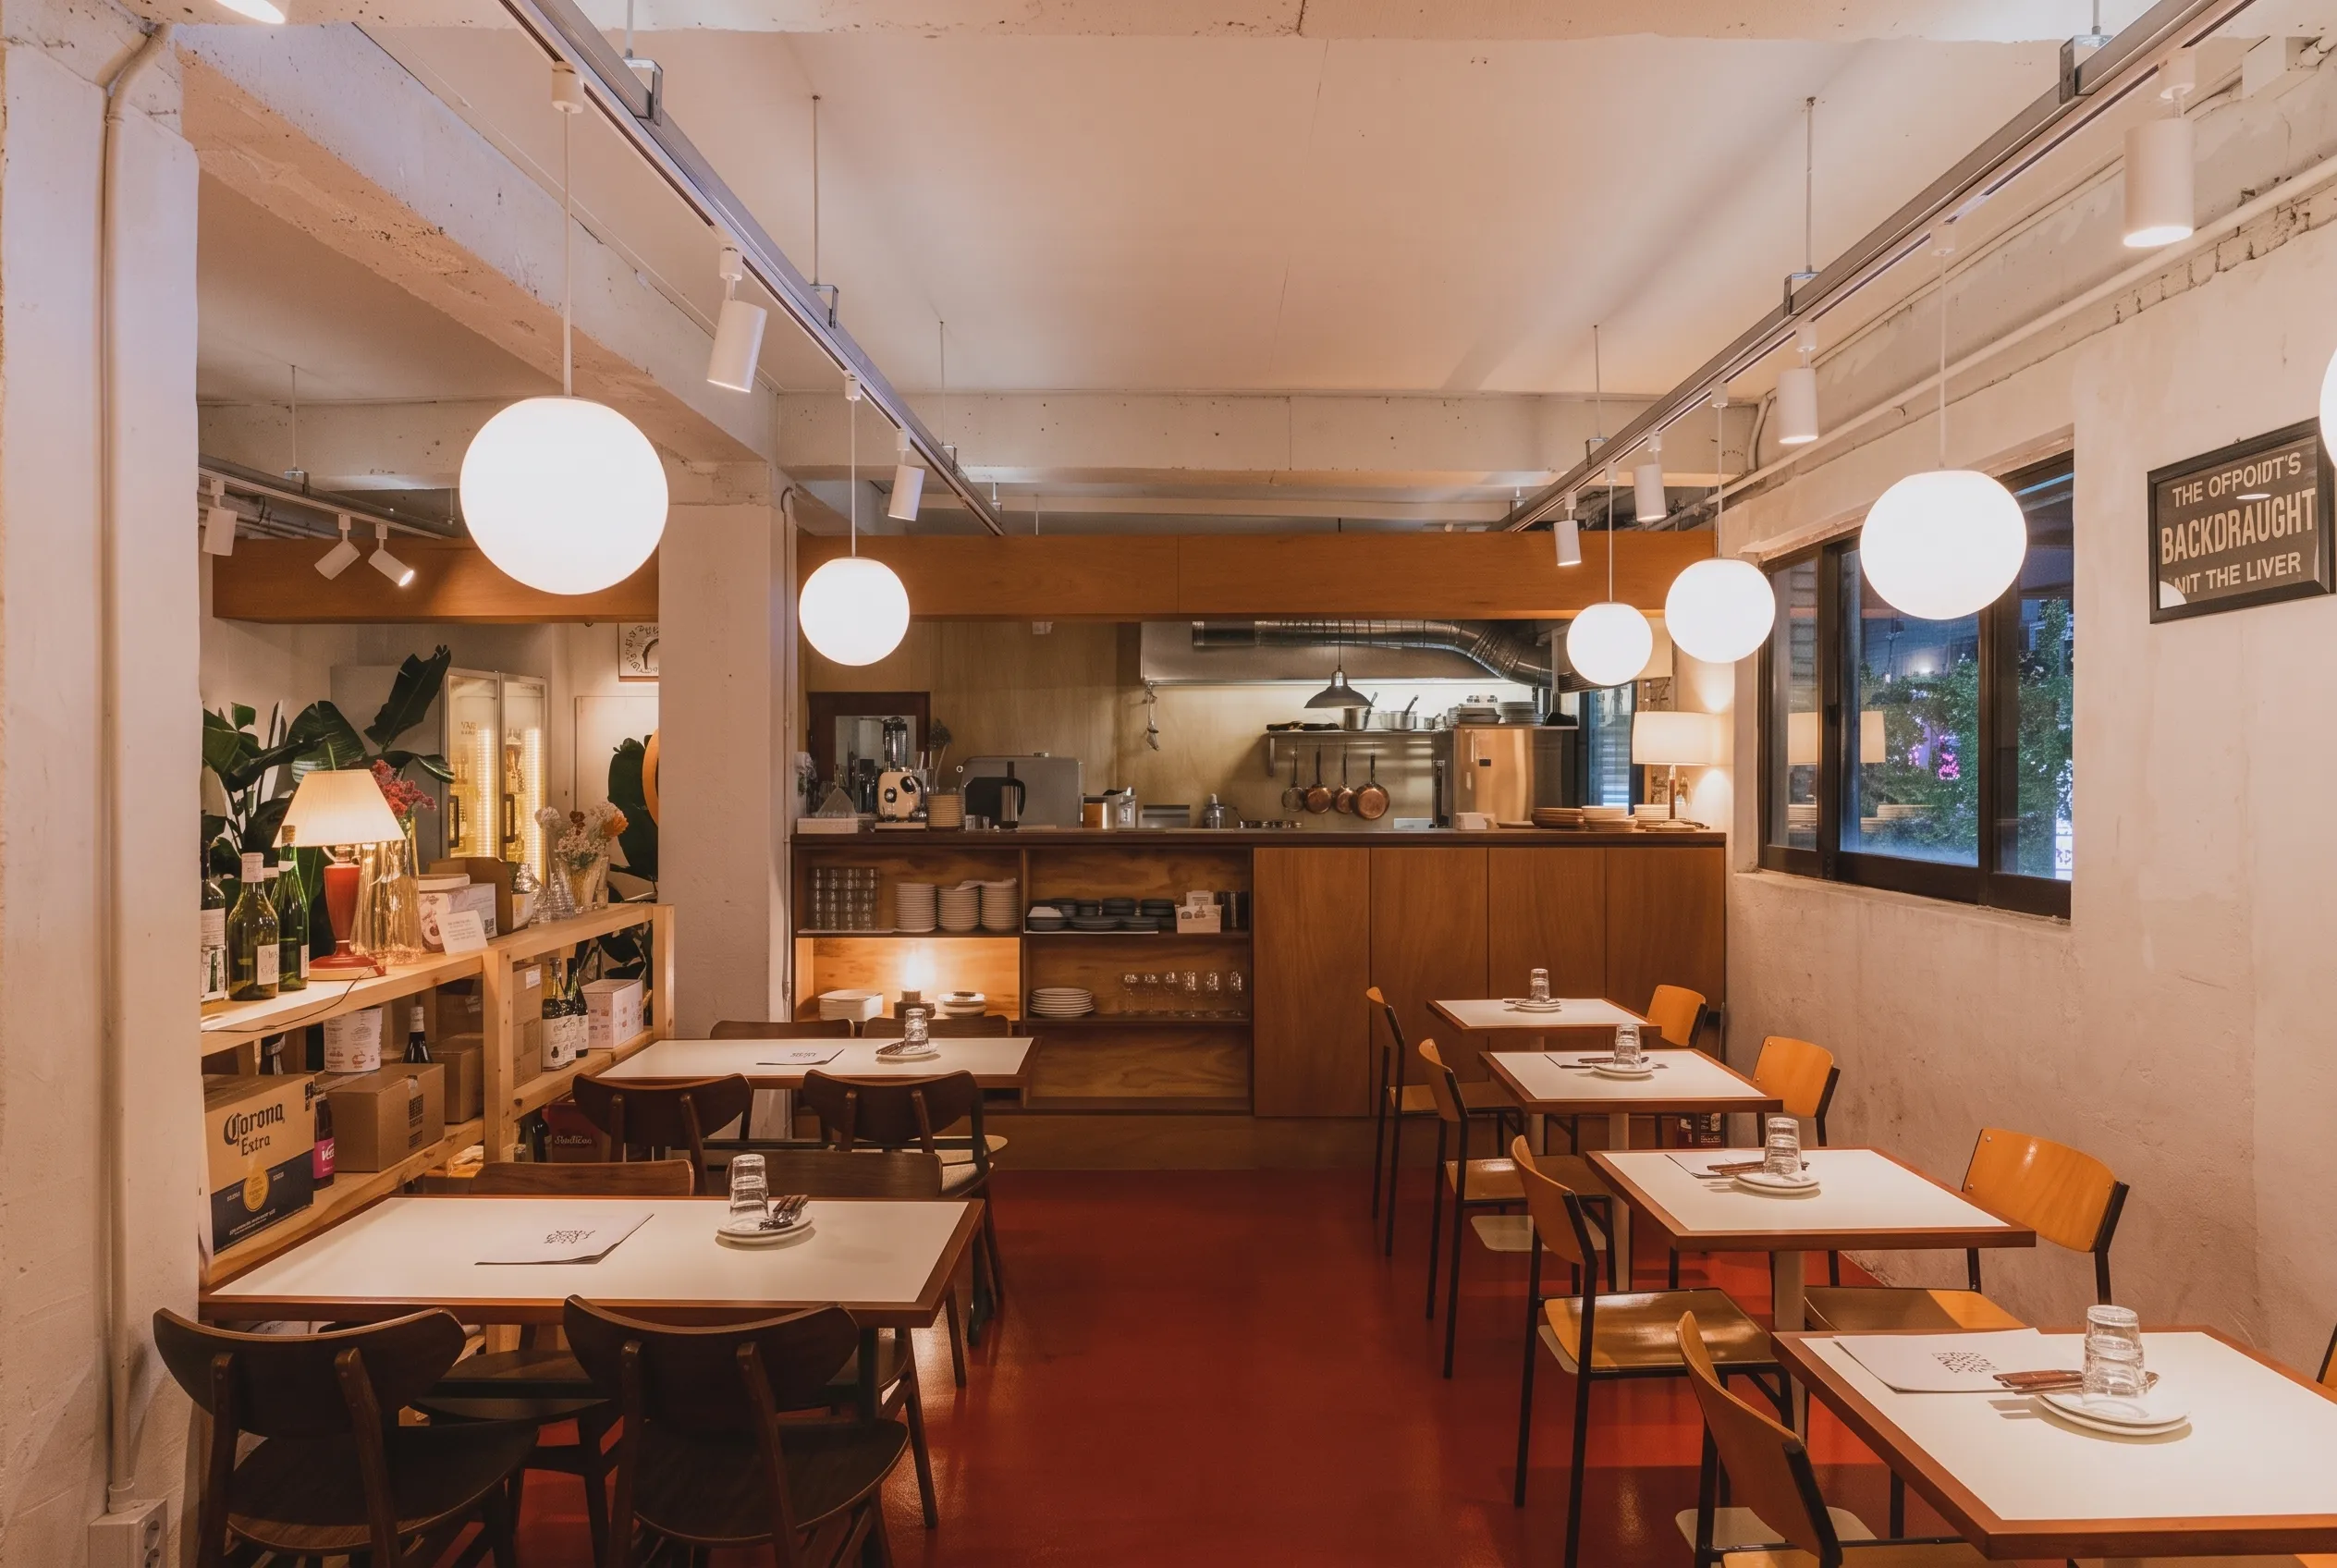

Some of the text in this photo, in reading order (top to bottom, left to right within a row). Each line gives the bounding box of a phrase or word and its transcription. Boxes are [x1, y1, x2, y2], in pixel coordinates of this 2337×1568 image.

[2172, 481, 2203, 508] THE
[2161, 488, 2316, 565] BACKDRAUGHT
[2206, 564, 2241, 590] THE
[2246, 552, 2302, 582] LIVER
[224, 1103, 284, 1146] Corona
[241, 1134, 271, 1157] Extra
